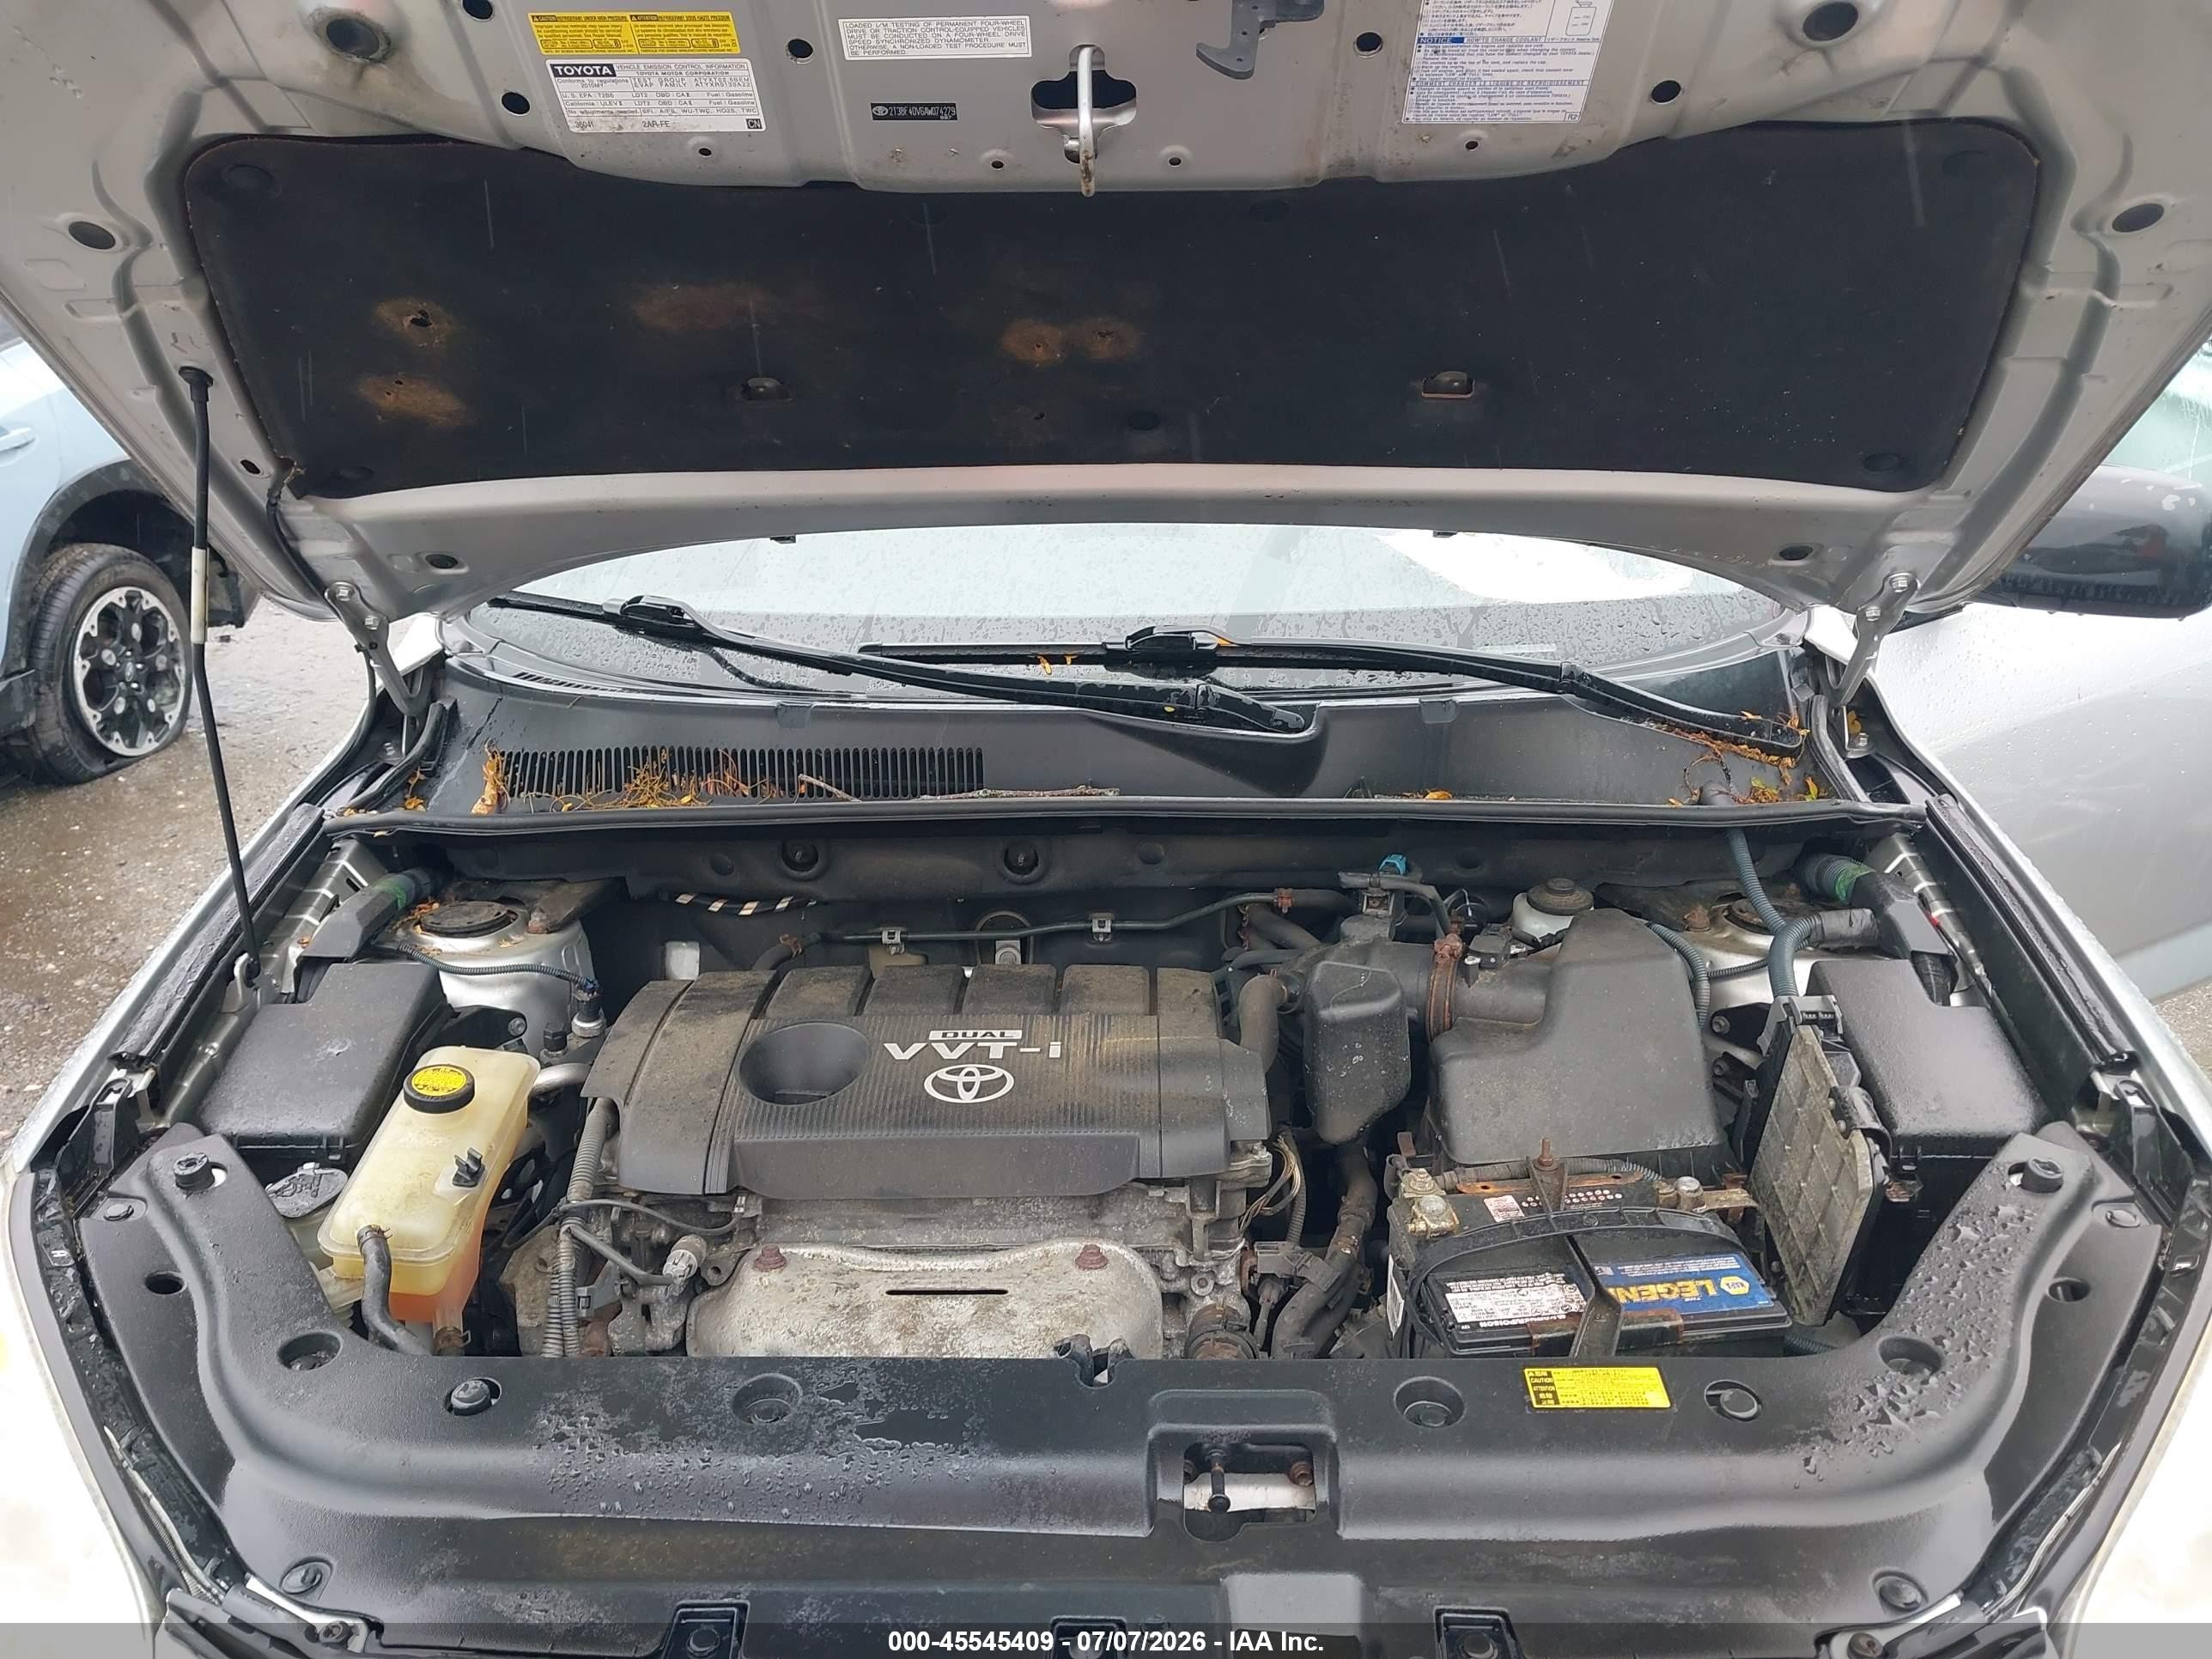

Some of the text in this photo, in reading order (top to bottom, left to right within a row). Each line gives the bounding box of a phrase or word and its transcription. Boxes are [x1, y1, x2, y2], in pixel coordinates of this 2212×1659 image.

[554, 65, 613, 76] TOYOTA
[747, 119, 761, 128] CN
[883, 1041, 1061, 1060] VVT-i
[1725, 1281, 1746, 1291] NAPA
